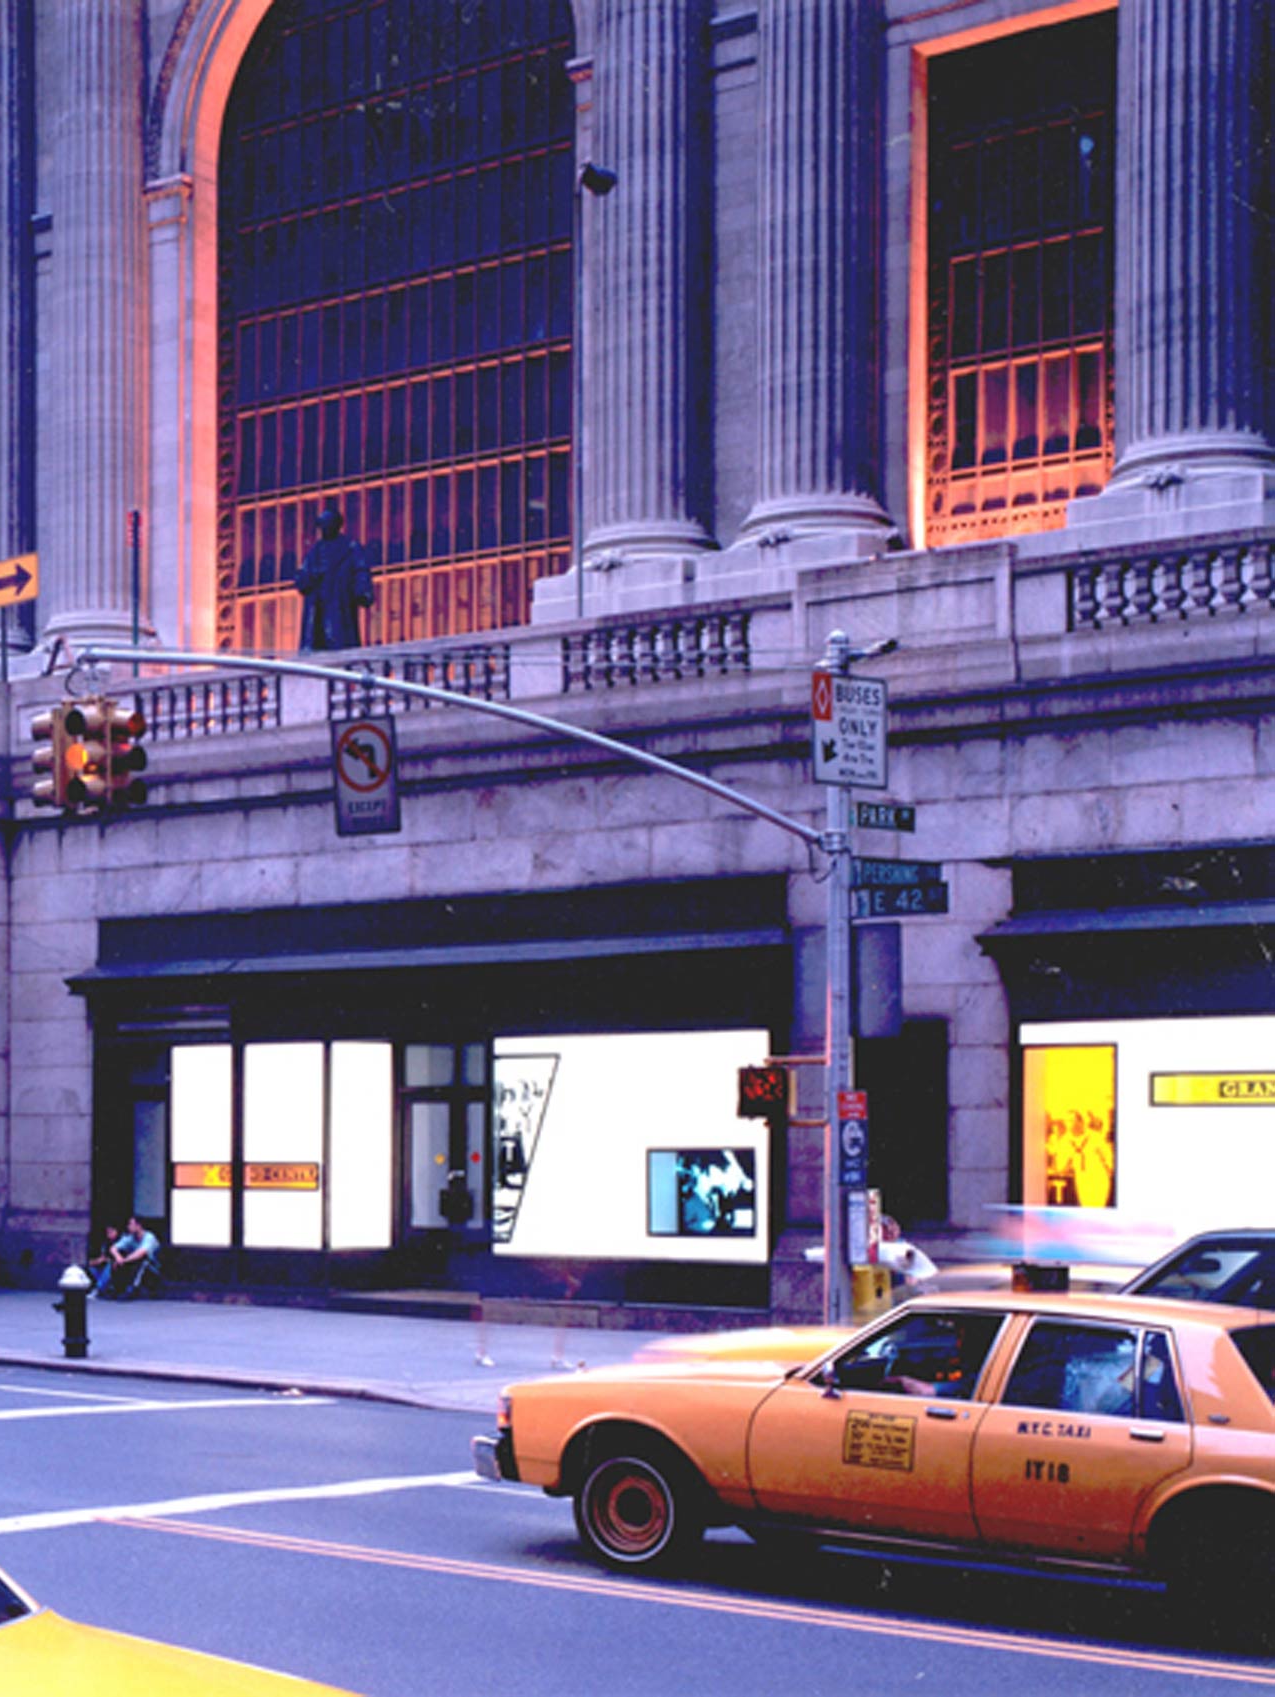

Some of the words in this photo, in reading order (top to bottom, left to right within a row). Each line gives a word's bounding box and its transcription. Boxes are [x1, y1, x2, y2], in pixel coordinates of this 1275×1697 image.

[836, 683, 880, 706] BUSES
[839, 716, 877, 737] ONLY
[860, 805, 895, 827] PARK
[874, 891, 886, 913] E
[894, 888, 924, 912] 42
[1057, 1423, 1092, 1439] TAXI
